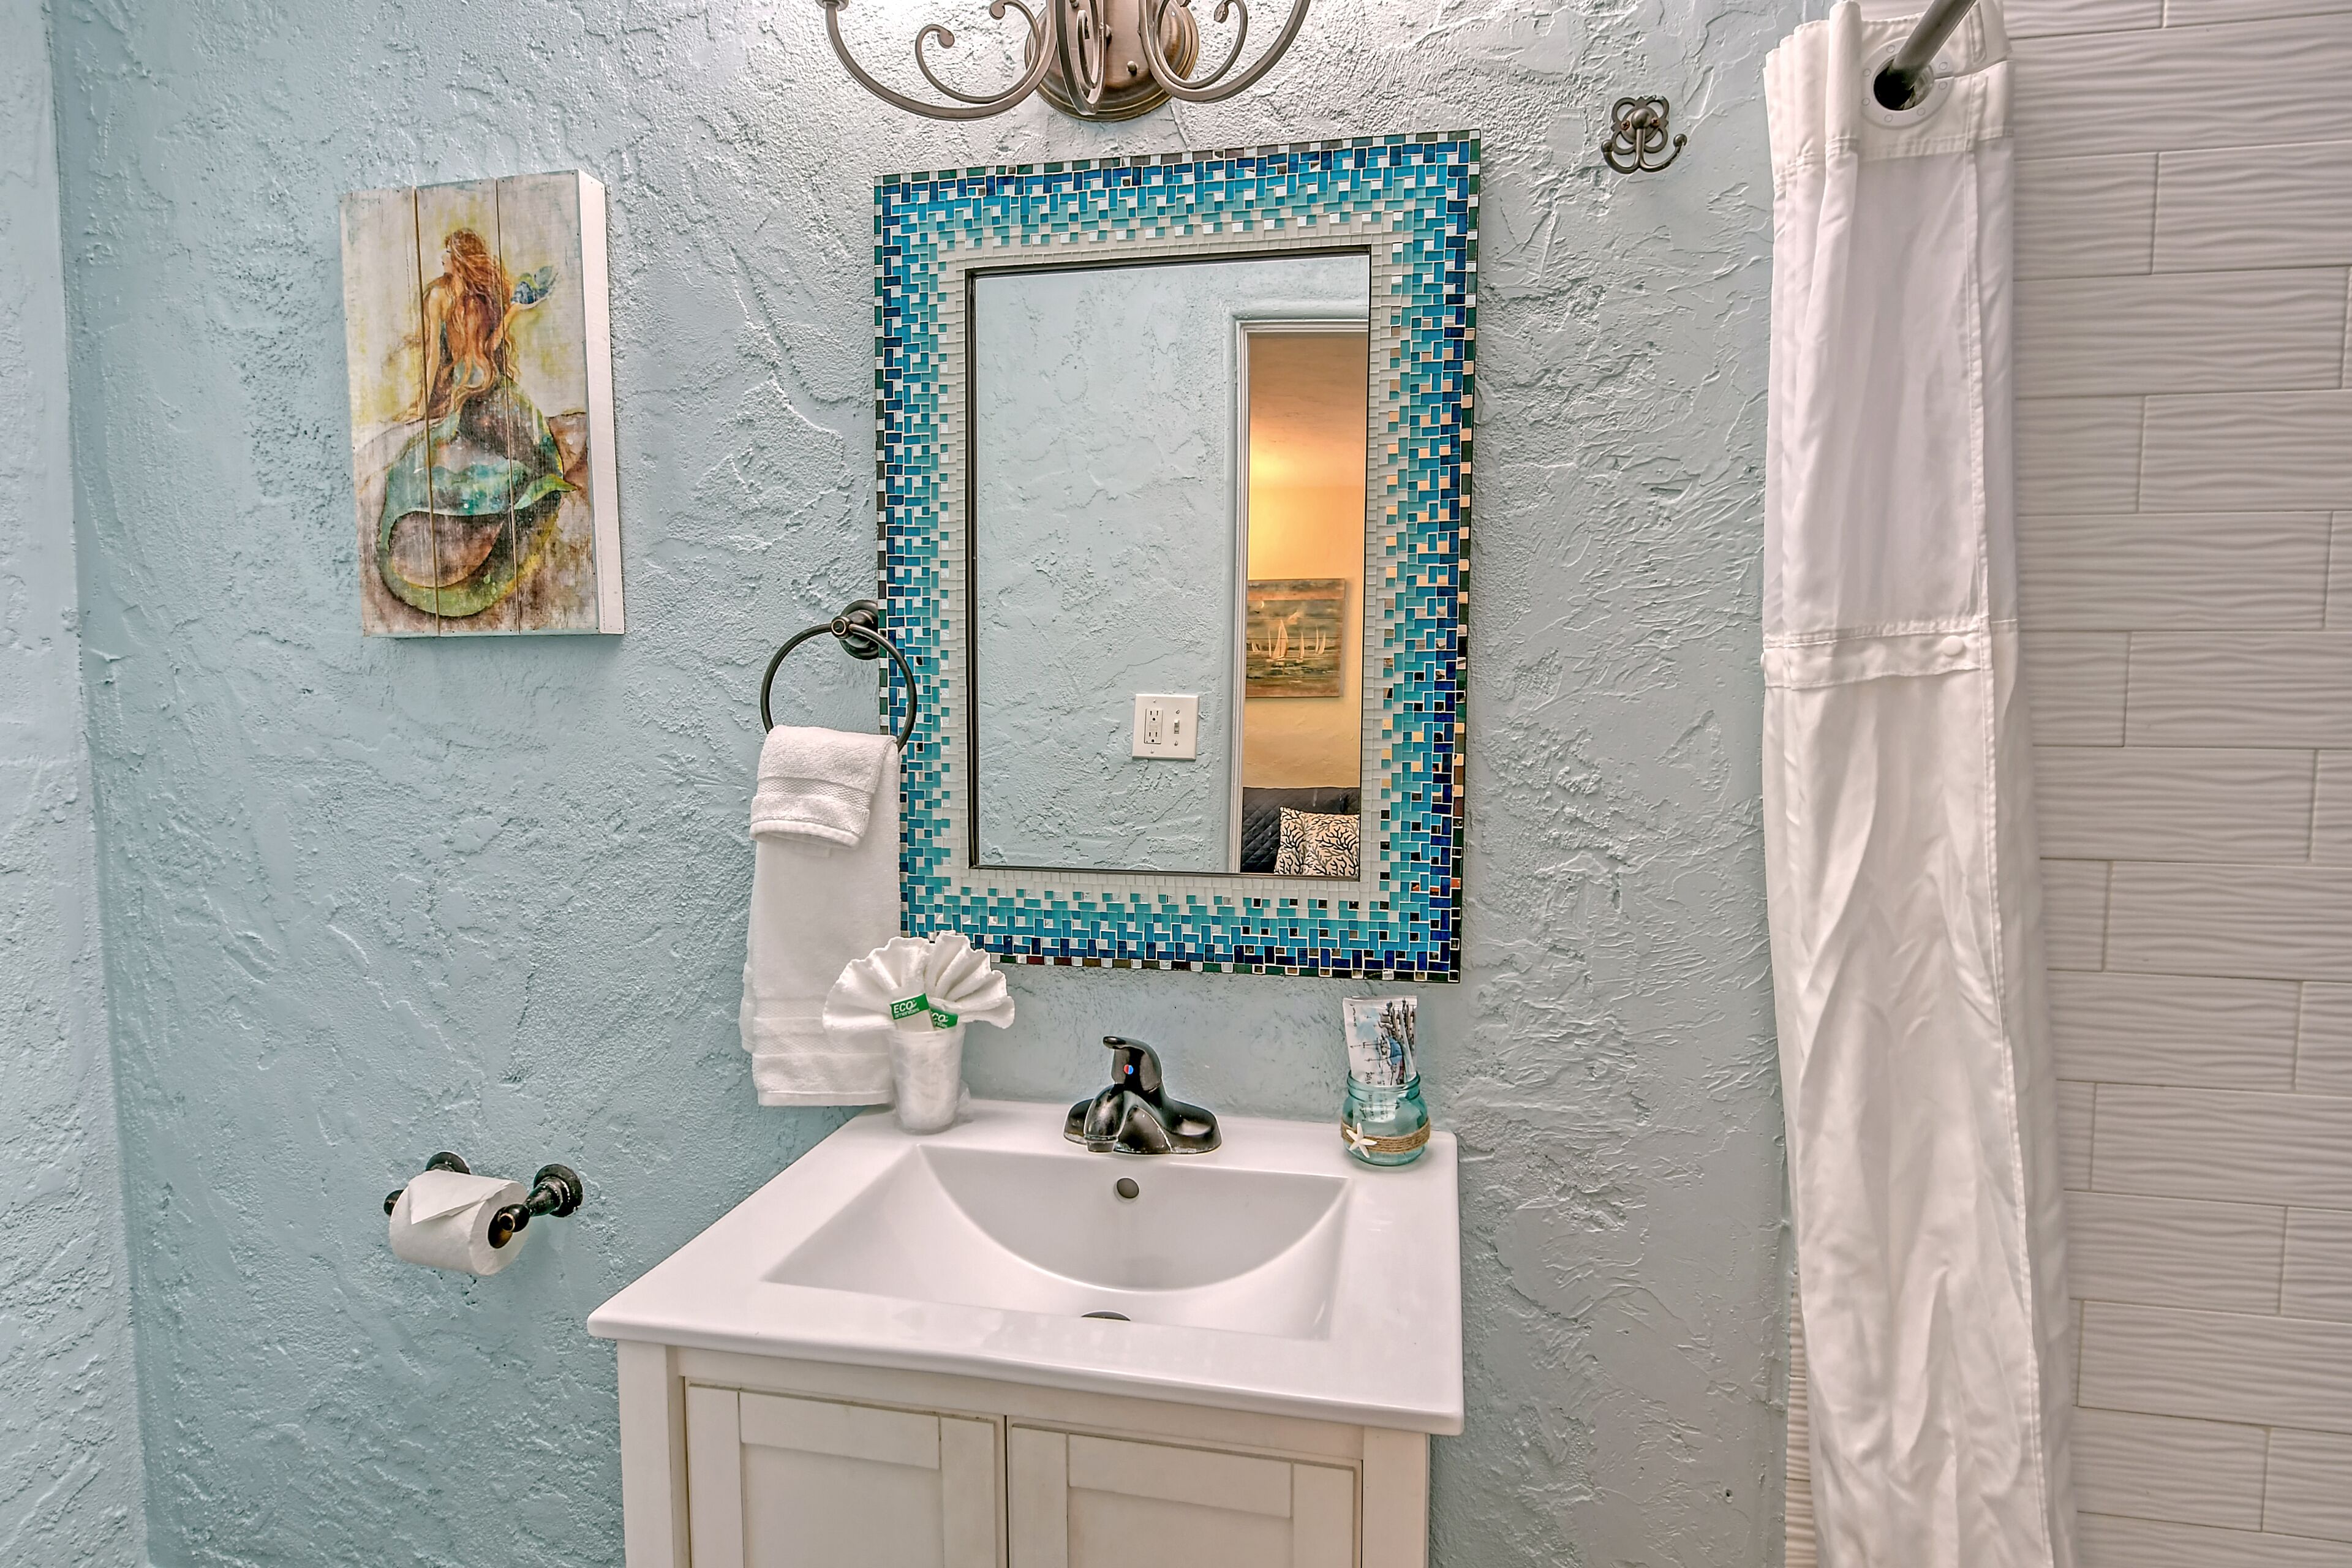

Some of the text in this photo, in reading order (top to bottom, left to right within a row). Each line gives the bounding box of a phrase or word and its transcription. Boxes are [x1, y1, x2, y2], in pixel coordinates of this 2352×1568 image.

[894, 1000, 916, 1014] ECO
[894, 1008, 920, 1018] amenities
[931, 1012, 948, 1022] CO
